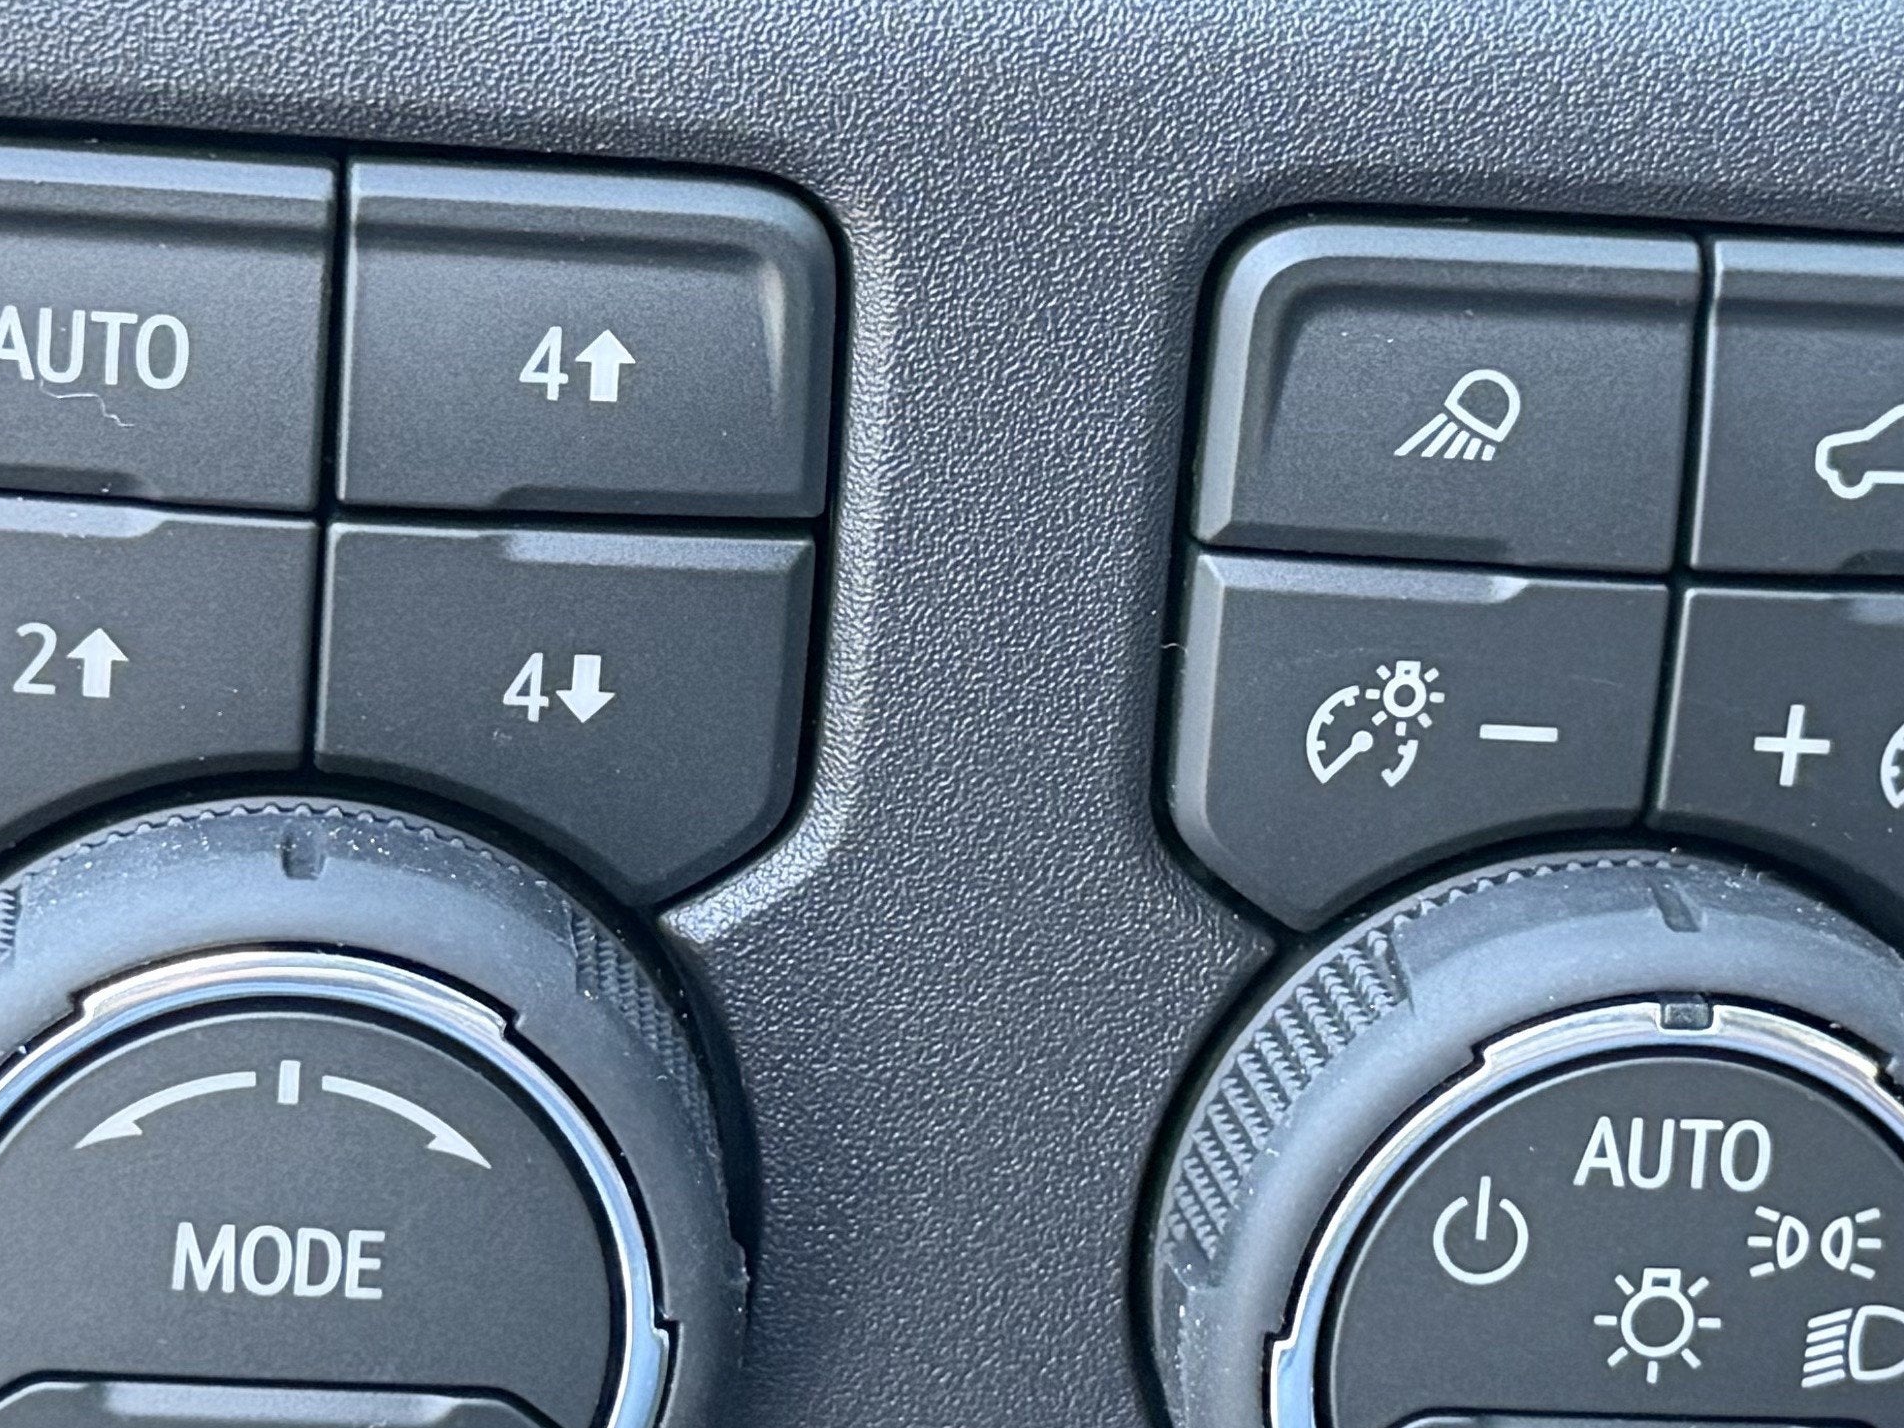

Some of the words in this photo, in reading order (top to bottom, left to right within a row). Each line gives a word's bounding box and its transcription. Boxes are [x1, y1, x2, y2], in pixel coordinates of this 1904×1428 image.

[518, 325, 569, 402] 4
[10, 621, 58, 697] 2
[502, 651, 550, 723] 4
[1572, 1115, 1773, 1193] AUTO
[167, 1220, 386, 1301] MODE
